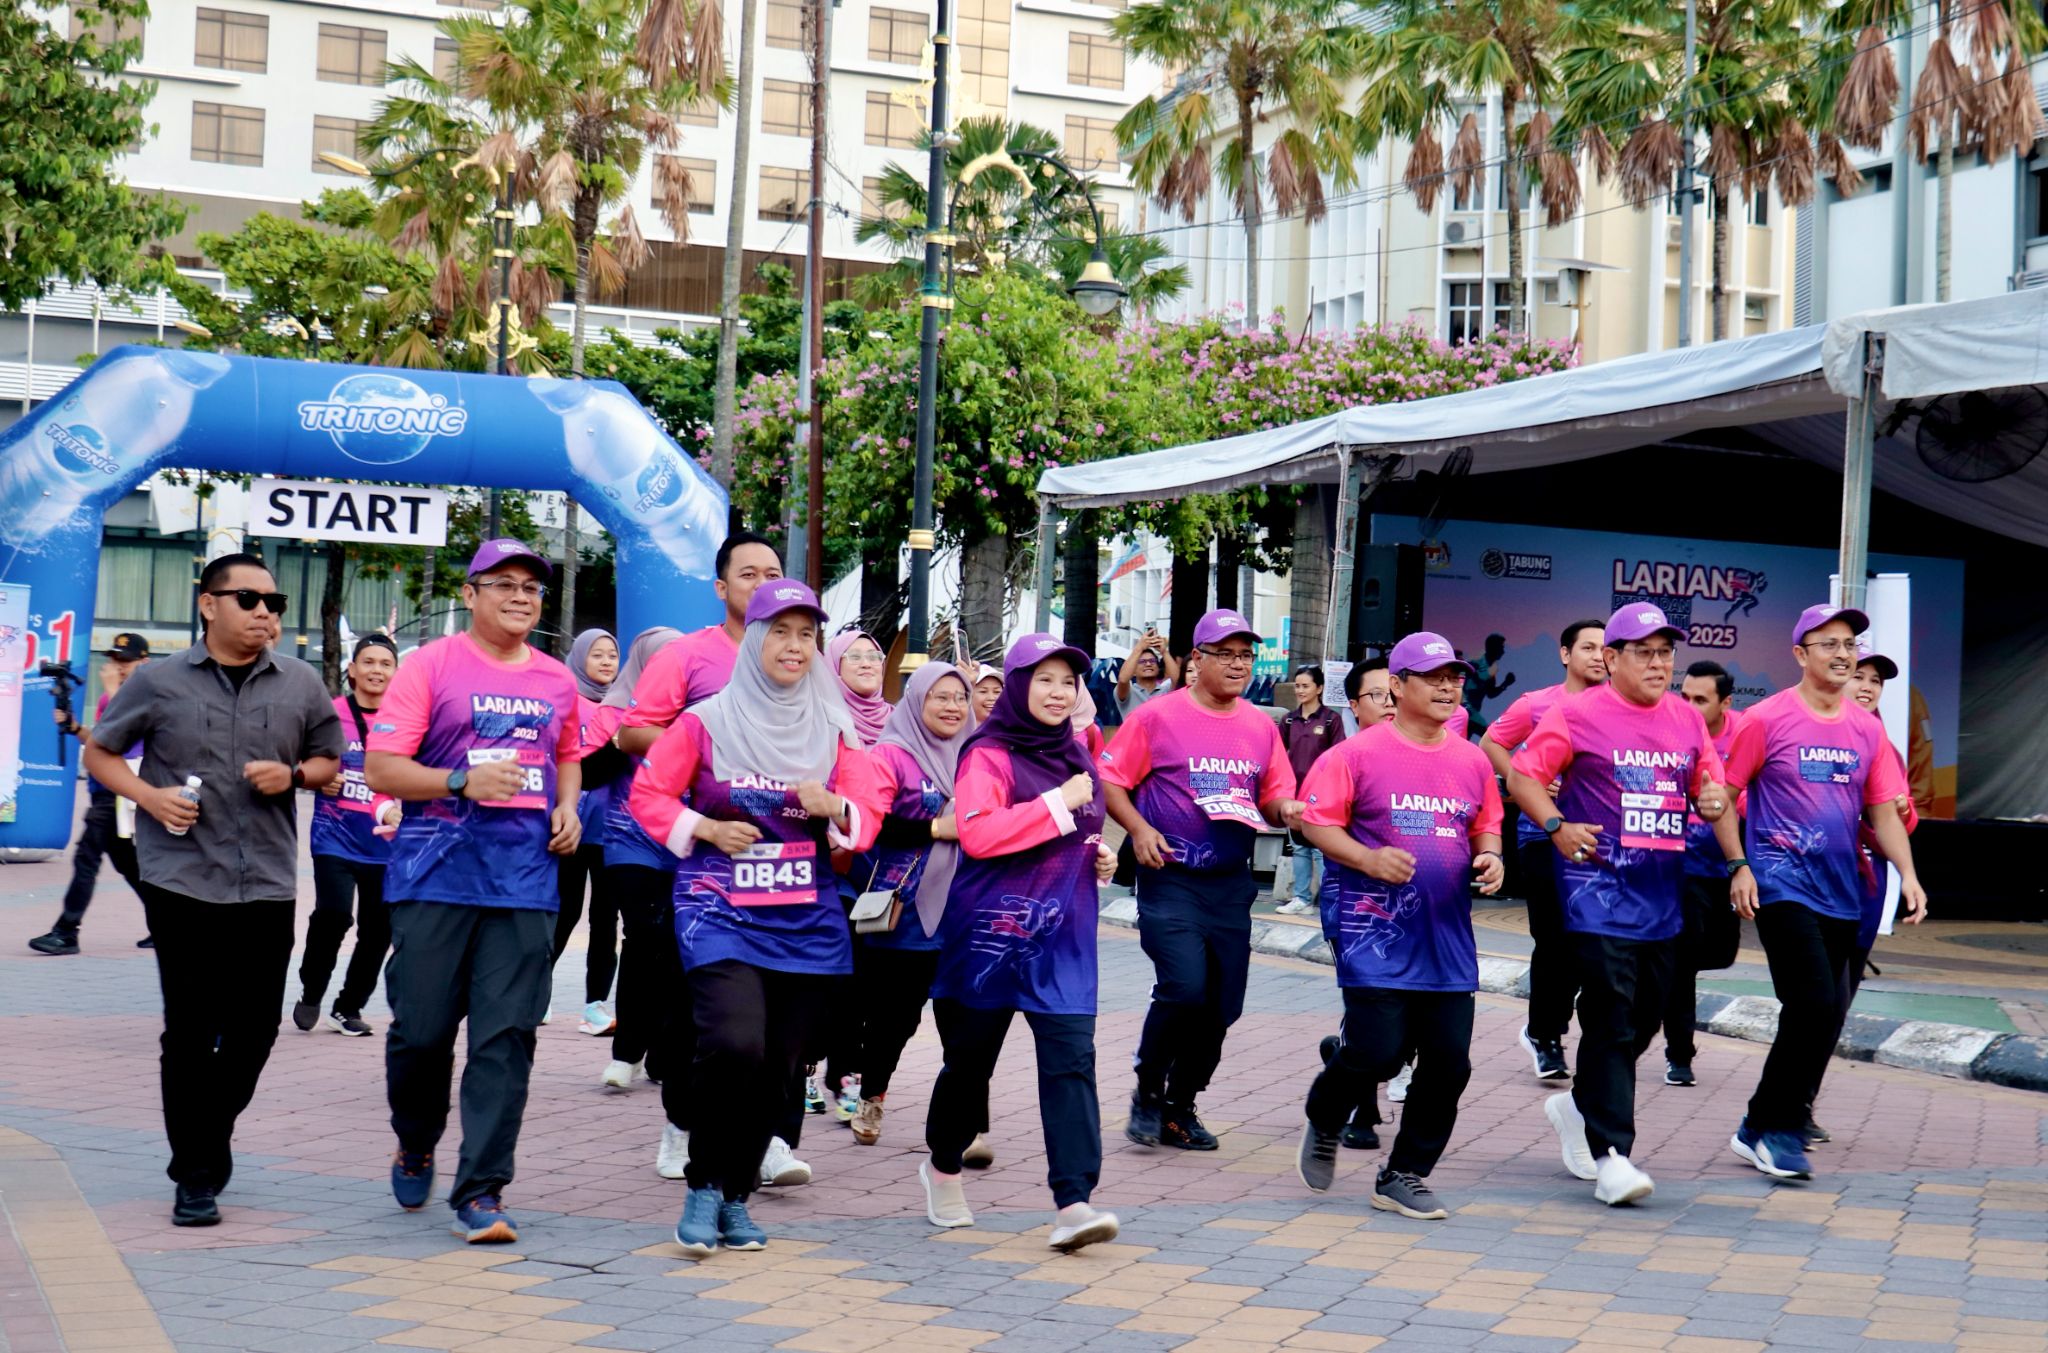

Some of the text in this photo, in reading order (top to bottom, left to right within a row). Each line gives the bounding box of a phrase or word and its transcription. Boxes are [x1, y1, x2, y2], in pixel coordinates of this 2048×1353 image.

[299, 394, 467, 437] TRITONIC
[45, 423, 120, 475] TRITONIC
[634, 452, 678, 514] TRITONIC
[267, 488, 431, 535] START
[1509, 555, 1550, 570] TABUNG
[1614, 561, 1734, 599] LARIAN
[1689, 625, 1735, 647] 2025
[473, 695, 541, 716] LARIAN
[513, 727, 538, 740] 2025
[1613, 750, 1677, 768] LARIAN
[1800, 747, 1850, 763] LARIAN
[1188, 757, 1249, 775] LARIAN
[1230, 787, 1251, 798] 2025
[1655, 781, 1677, 792] 2025
[782, 807, 810, 820] 202
[1391, 793, 1456, 814] LARIAN
[1435, 826, 1457, 838] 2025
[1624, 810, 1682, 835] 0845
[735, 860, 812, 888] 0843
